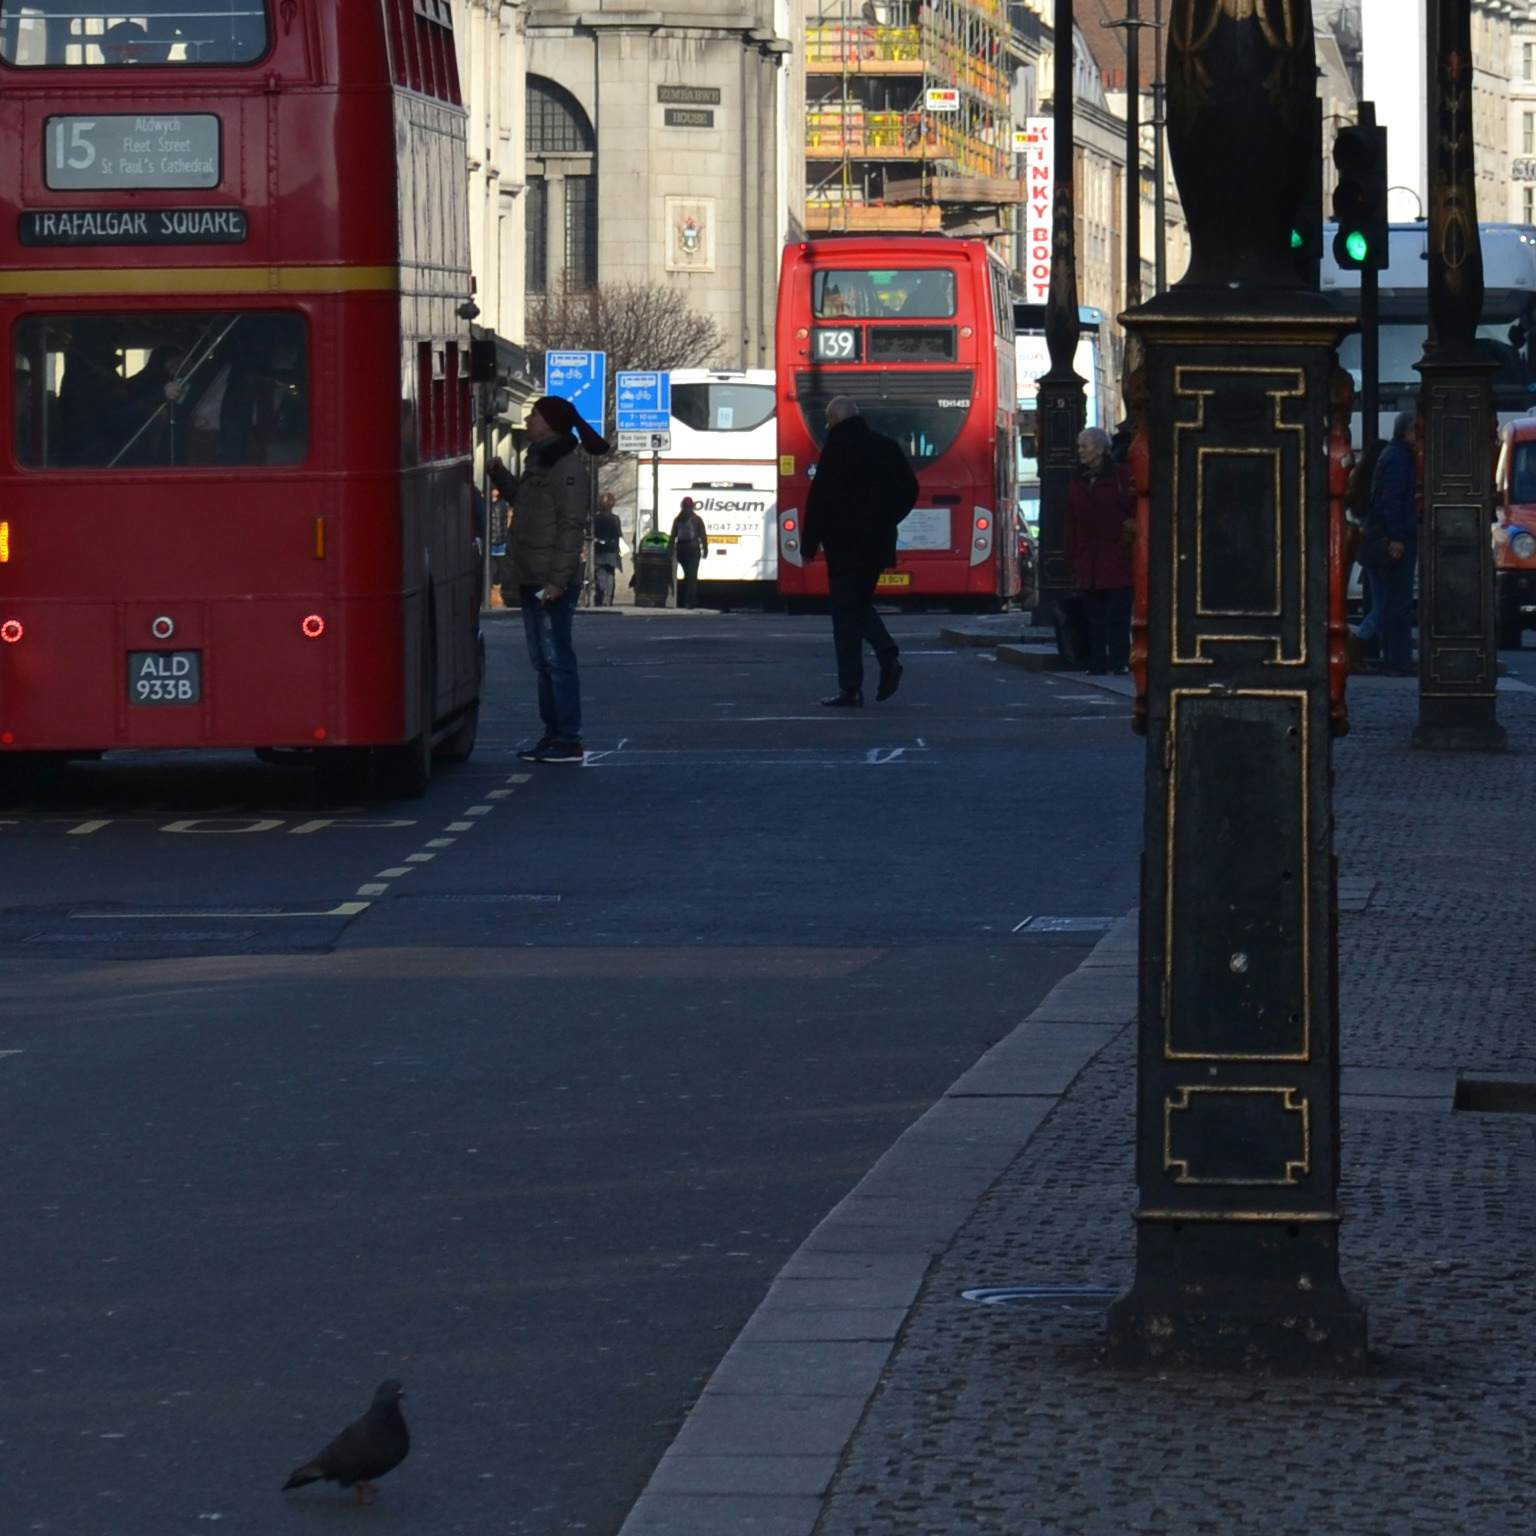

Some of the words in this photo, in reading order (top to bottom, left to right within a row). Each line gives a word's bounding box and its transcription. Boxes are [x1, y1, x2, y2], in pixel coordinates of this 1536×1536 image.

[135, 117, 181, 136] Aldwych
[55, 121, 97, 170] 15
[122, 138, 152, 153] Fleet
[158, 137, 192, 153] Street
[101, 158, 113, 175] St
[119, 158, 155, 175] Paul's
[160, 158, 215, 175] Cathedral
[33, 212, 149, 236] TRAFALGAR
[160, 211, 242, 235] SQUARE
[818, 331, 854, 357] 139
[693, 498, 765, 512] oliseum
[139, 656, 190, 677] ALD
[136, 679, 193, 700] 933B
